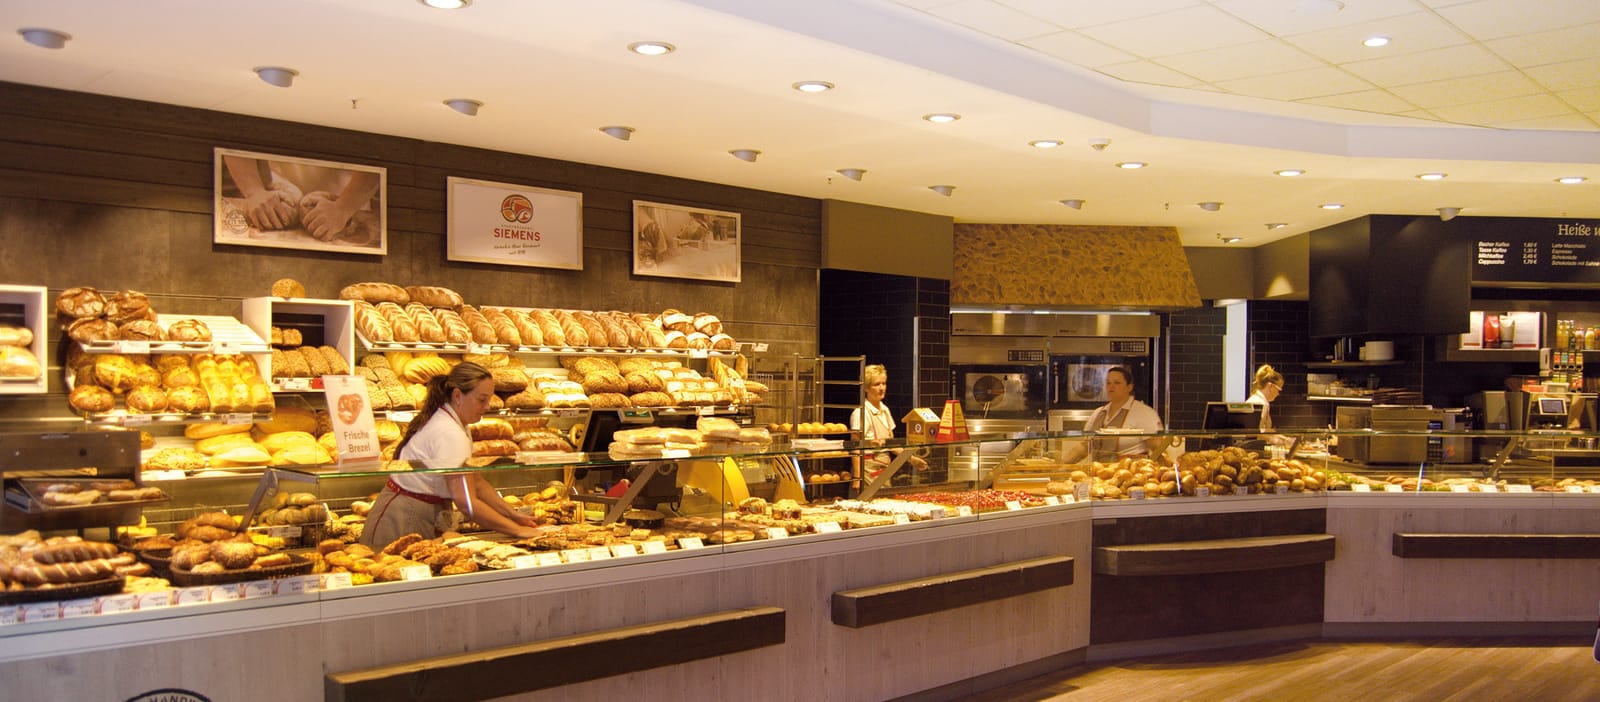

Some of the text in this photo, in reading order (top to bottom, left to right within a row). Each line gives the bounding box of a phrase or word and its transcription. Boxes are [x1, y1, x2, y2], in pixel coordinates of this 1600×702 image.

[494, 228, 541, 241] SIEMENS
[1558, 222, 1591, 236] Heiße
[343, 431, 370, 441] Frische
[348, 443, 370, 453] Brezel
